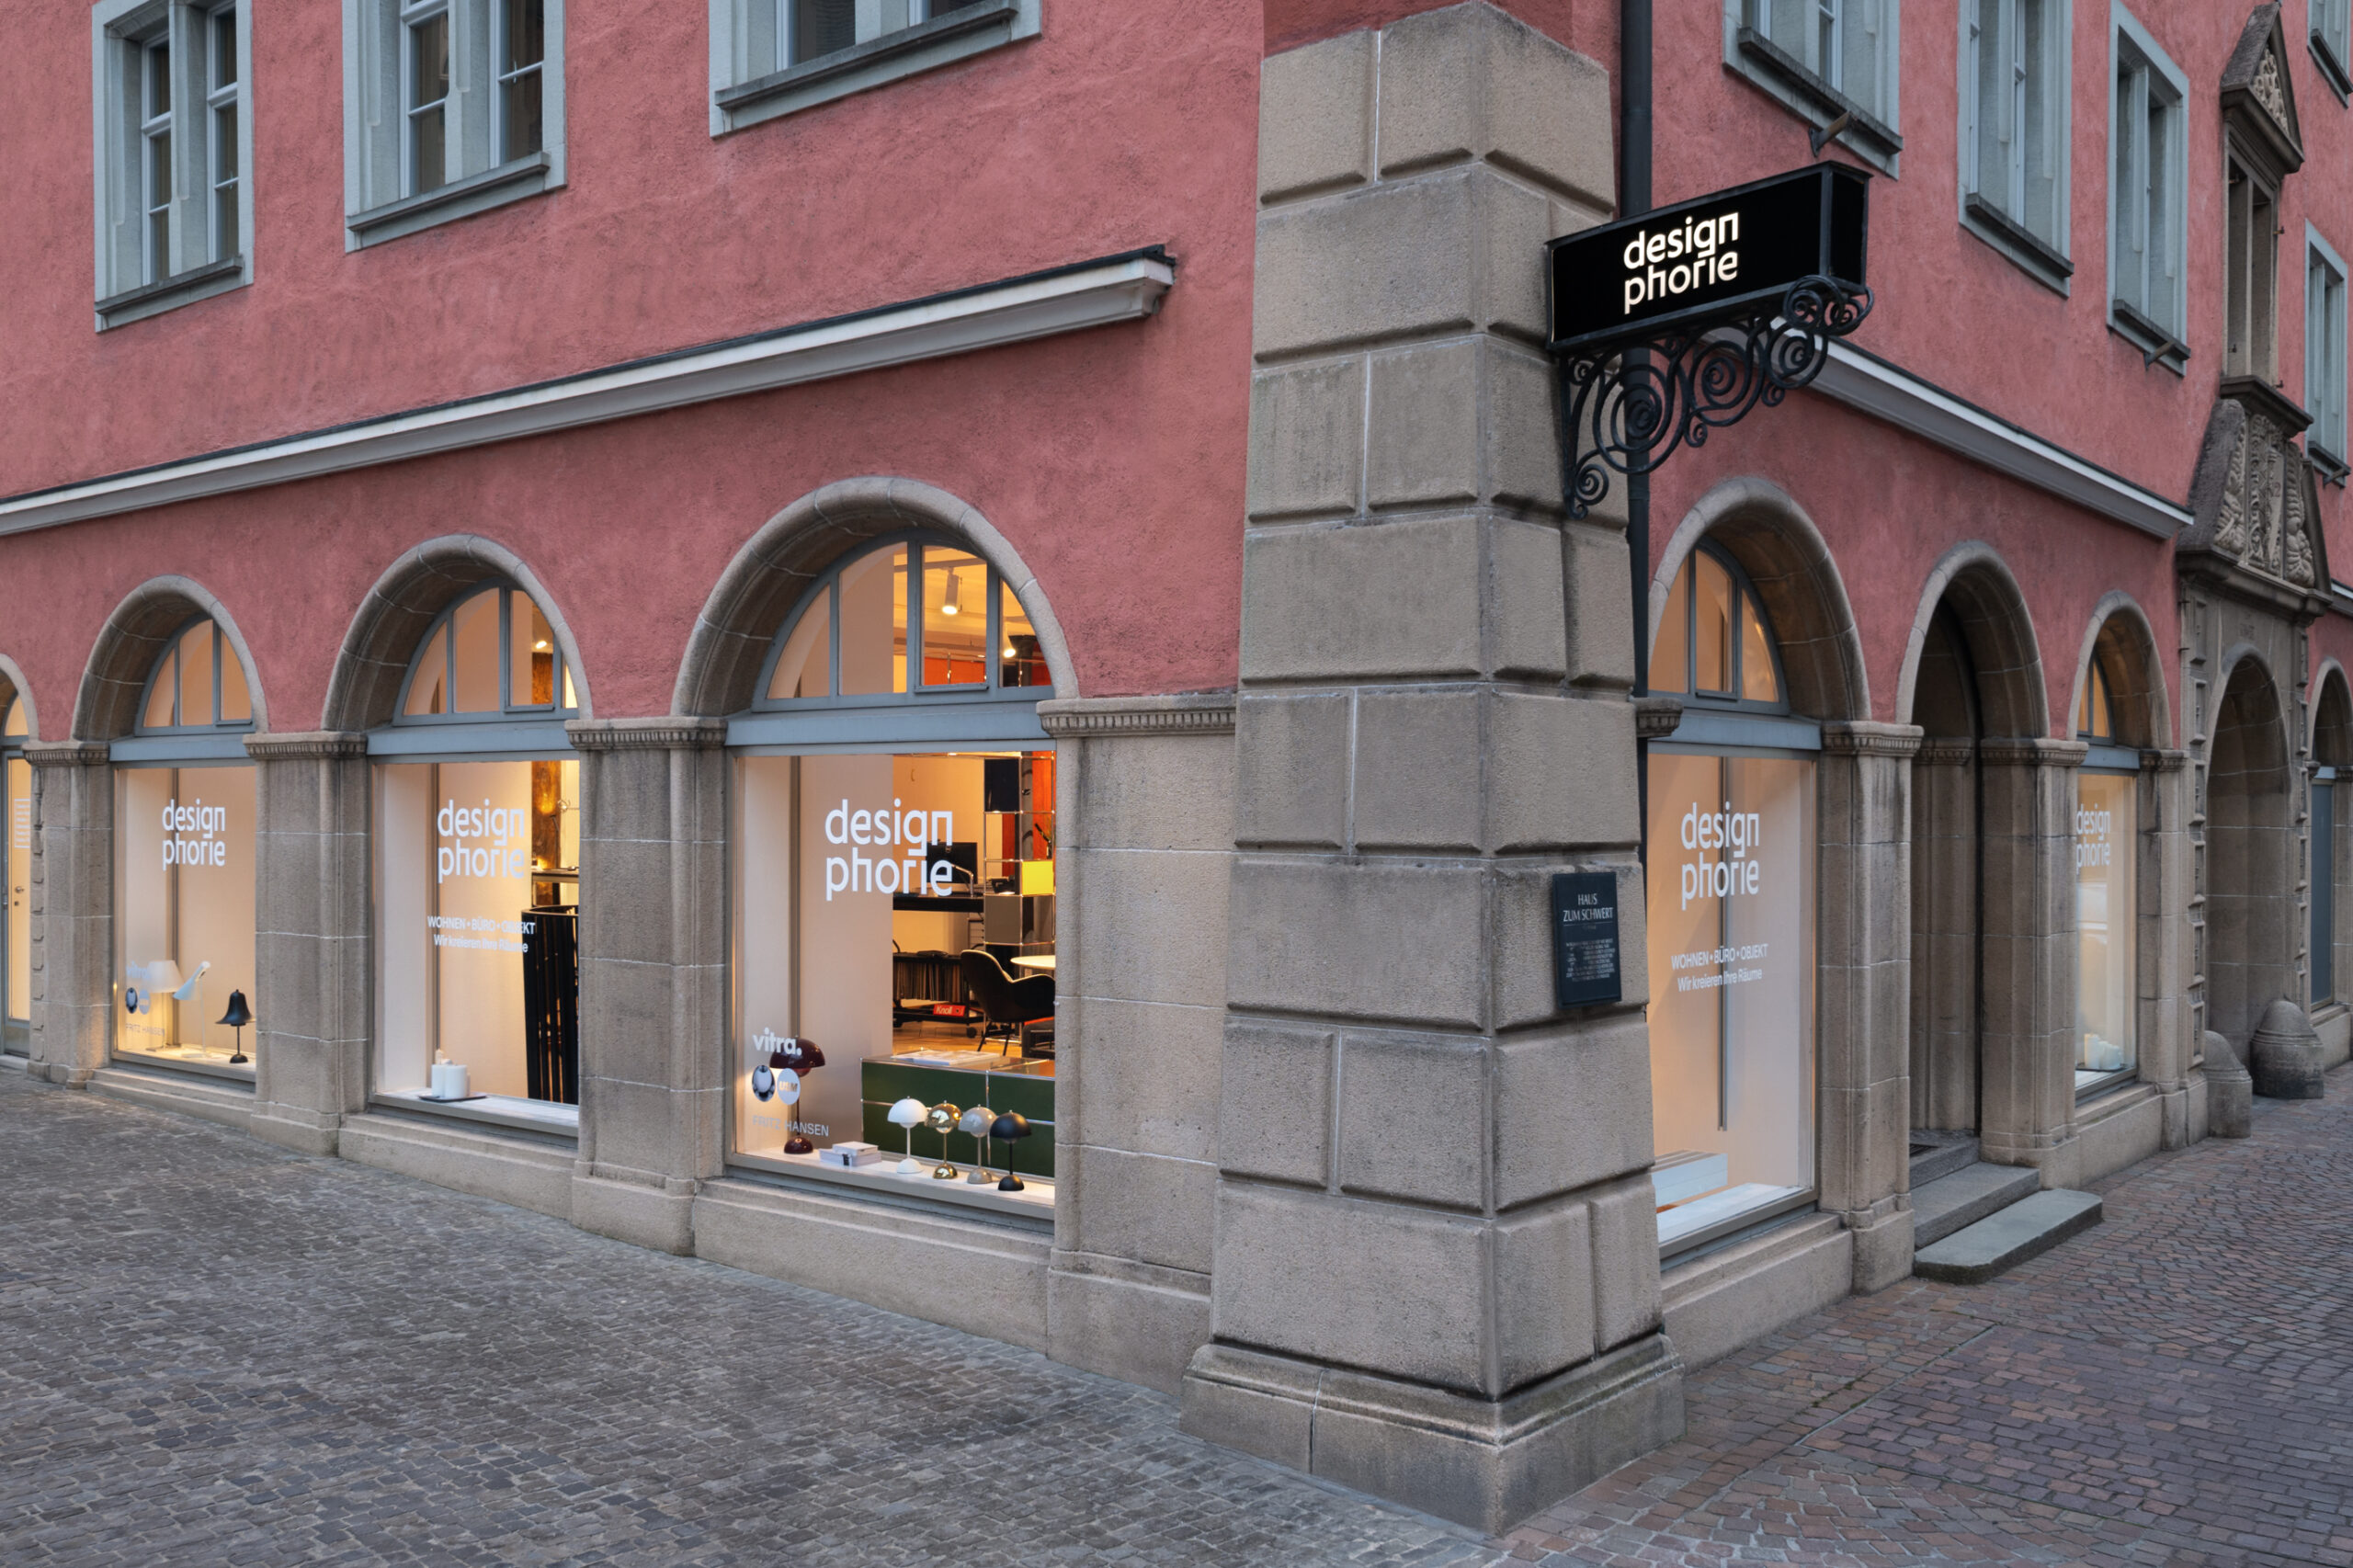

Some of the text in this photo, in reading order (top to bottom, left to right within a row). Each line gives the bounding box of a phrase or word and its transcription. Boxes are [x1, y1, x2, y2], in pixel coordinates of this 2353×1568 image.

[1623, 212, 1739, 269] design
[1624, 251, 1738, 315] phorie
[162, 798, 226, 839] design
[438, 798, 525, 846] design
[824, 798, 953, 857] design
[1681, 801, 1759, 858] design
[2077, 803, 2110, 841] design
[162, 832, 226, 871] phorie
[438, 838, 525, 884] phorie
[2076, 836, 2110, 875] phorie
[825, 846, 953, 902] phorie
[1681, 851, 1759, 911] phorie
[1563, 907, 1613, 922] ZUM SCHWERT
[1577, 892, 1597, 905] HAUS
[427, 915, 535, 935] WOHNEN BÜRO OBJEKT
[1671, 943, 1768, 971] WOHNEN BÜRO OBJEKT
[1677, 968, 1763, 993] Wir kreieren Ihre Räume
[936, 1005, 953, 1016] Knoll
[752, 1115, 829, 1137] FRITZ HANSEN
